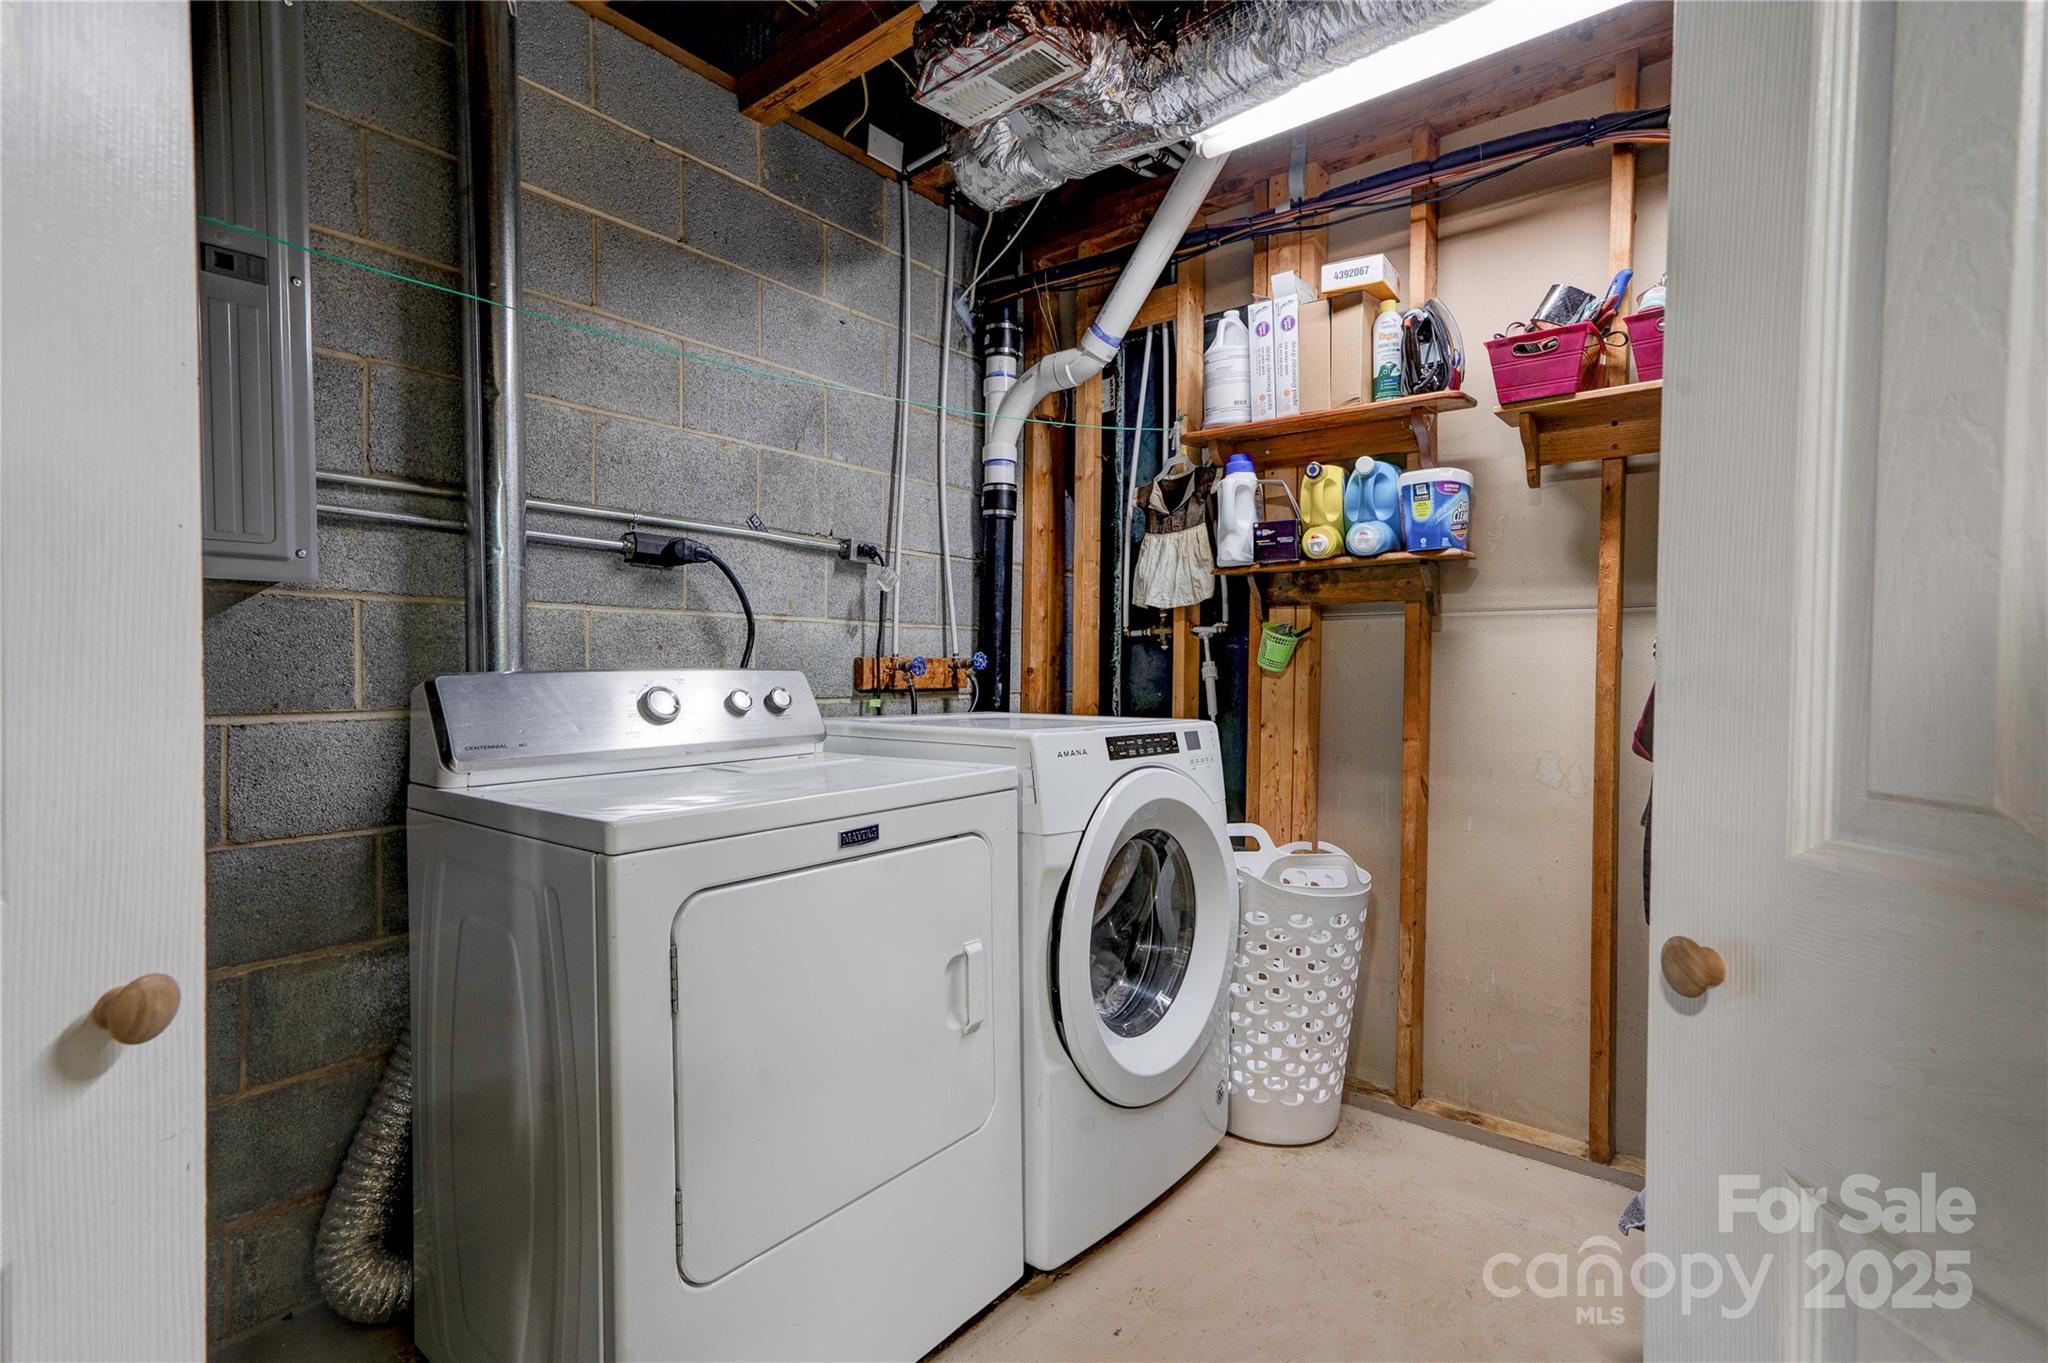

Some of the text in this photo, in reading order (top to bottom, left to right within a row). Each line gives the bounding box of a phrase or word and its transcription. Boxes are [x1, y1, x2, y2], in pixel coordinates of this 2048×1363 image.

[1334, 265, 1370, 280] 4392067
[1057, 748, 1088, 758] AMANA
[842, 827, 878, 844] MAYTAG
